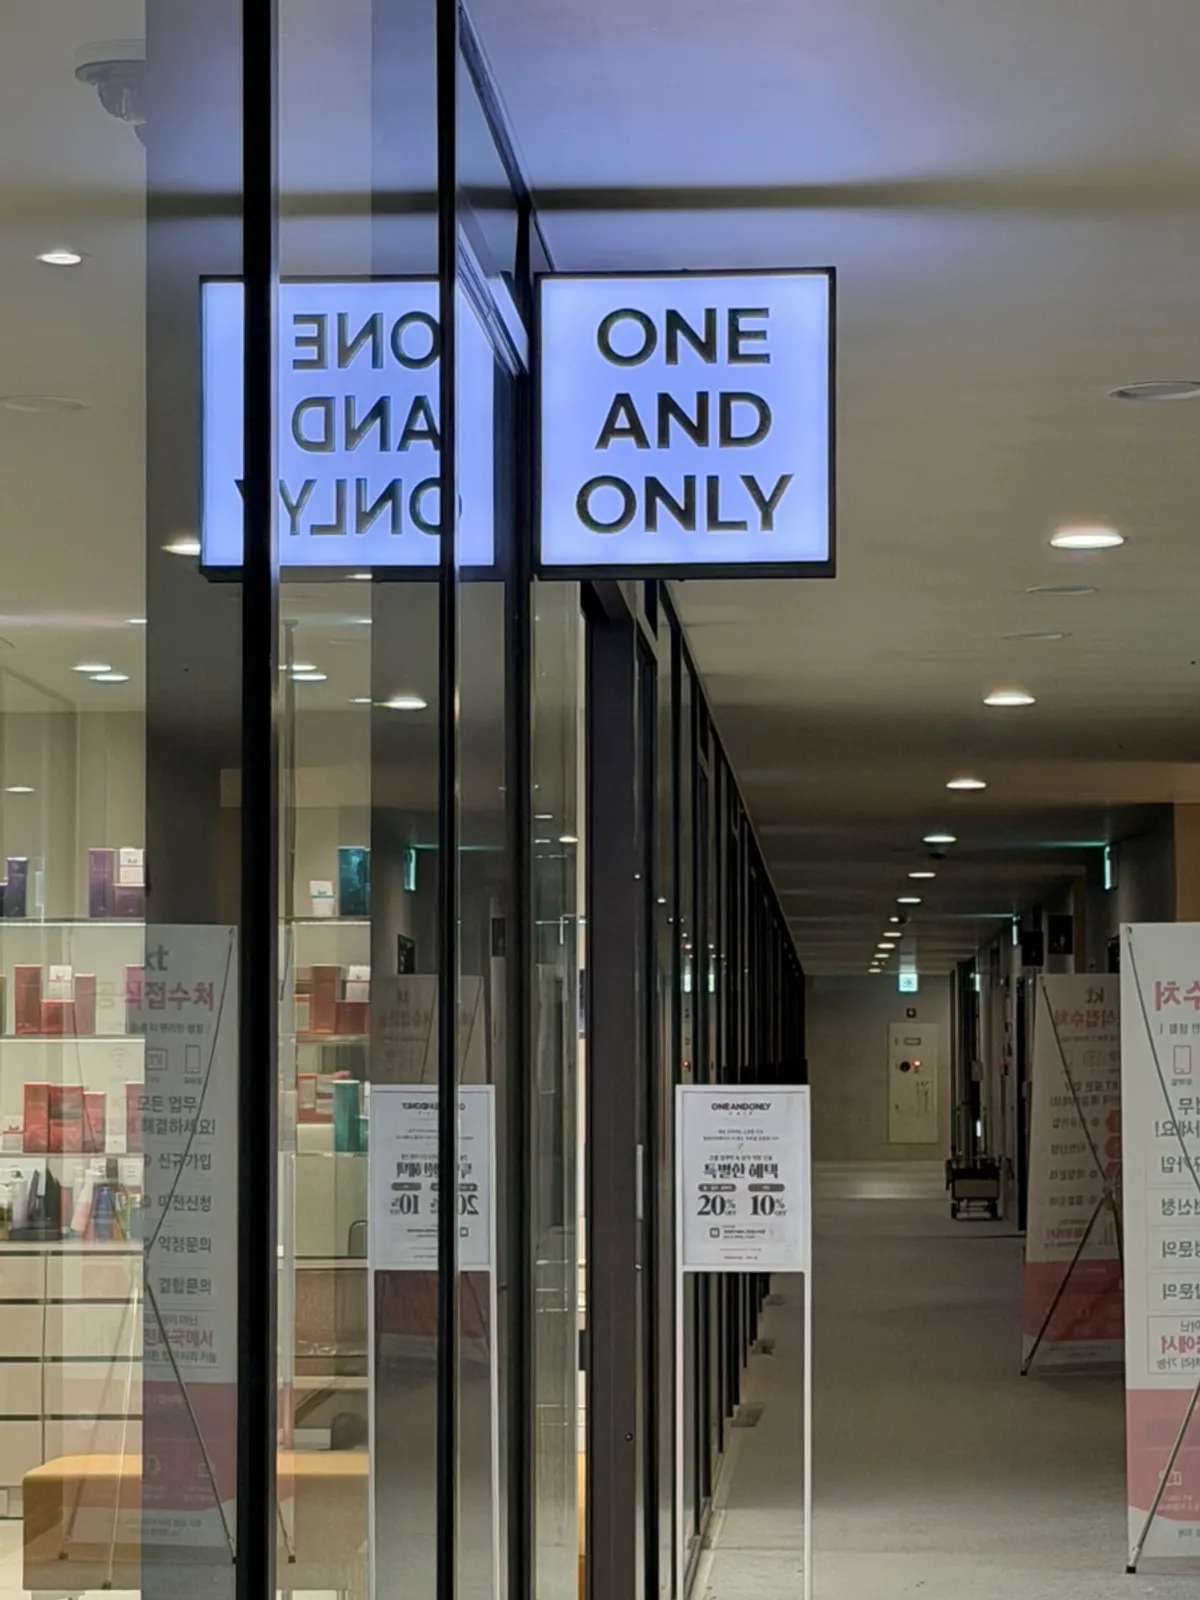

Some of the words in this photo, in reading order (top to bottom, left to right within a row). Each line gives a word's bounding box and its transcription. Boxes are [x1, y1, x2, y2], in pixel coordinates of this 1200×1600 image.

[596, 308, 771, 366] ONE
[594, 392, 772, 449] AND
[576, 474, 794, 534] ONLY
[168, 1096, 197, 1114] 업무
[158, 1153, 212, 1170] 신규가입
[703, 1163, 746, 1179] 특별한
[748, 1163, 779, 1179] 혜택
